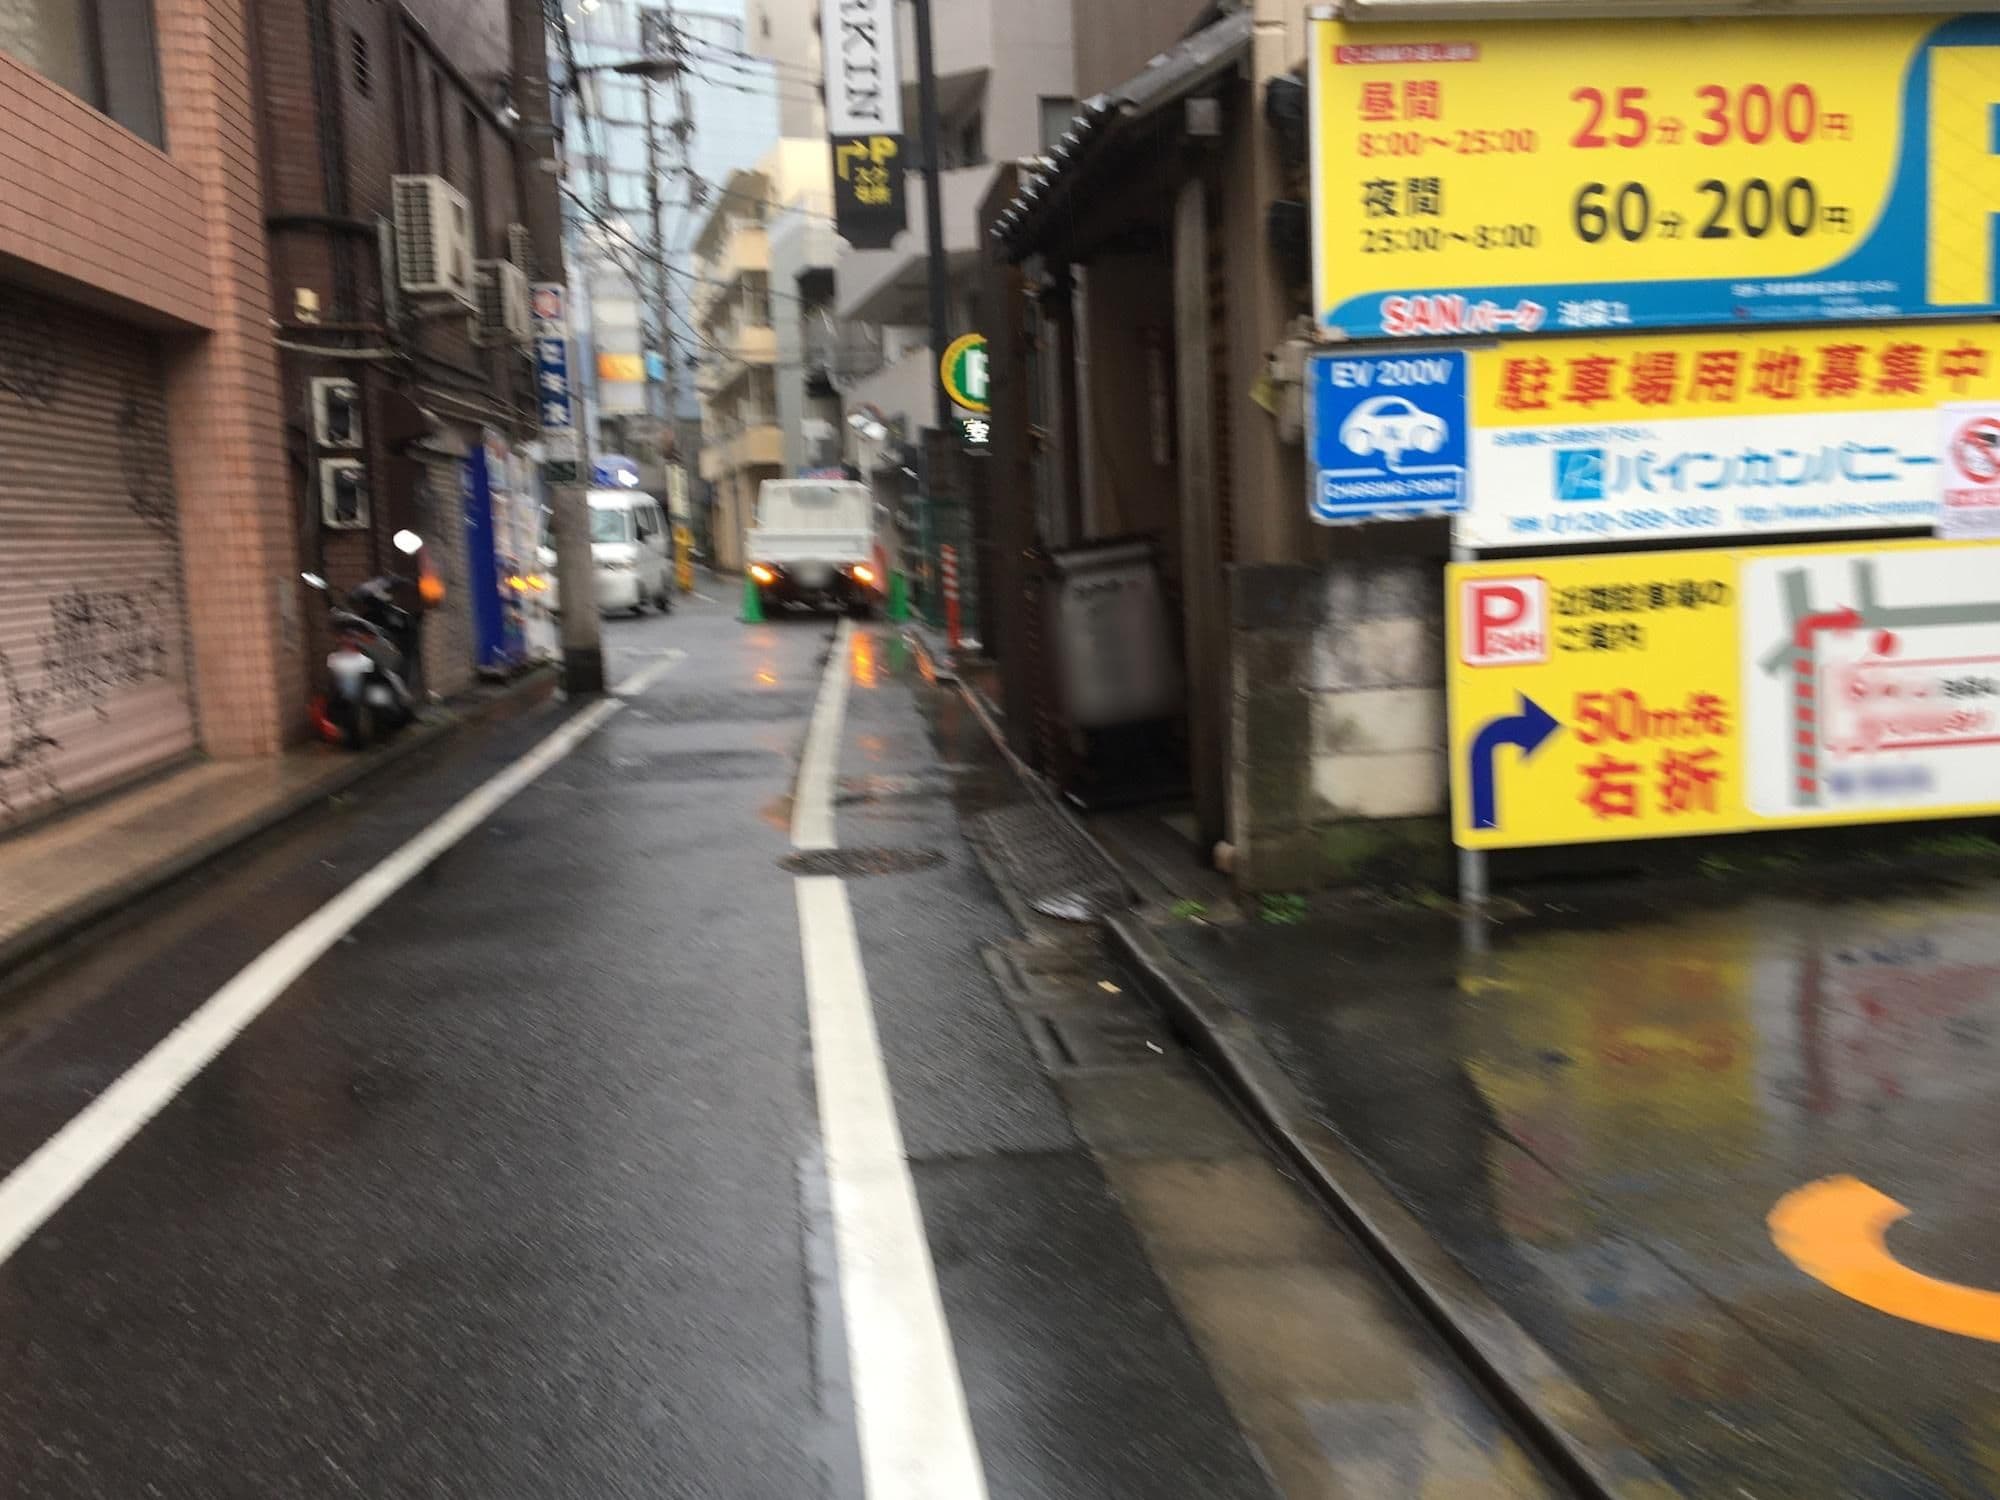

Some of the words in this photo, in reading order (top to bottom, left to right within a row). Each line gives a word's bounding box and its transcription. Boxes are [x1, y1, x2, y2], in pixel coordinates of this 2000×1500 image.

[1331, 360, 1375, 388] EV
[1376, 358, 1453, 387] 200V
[1576, 747, 1723, 818] 右折
